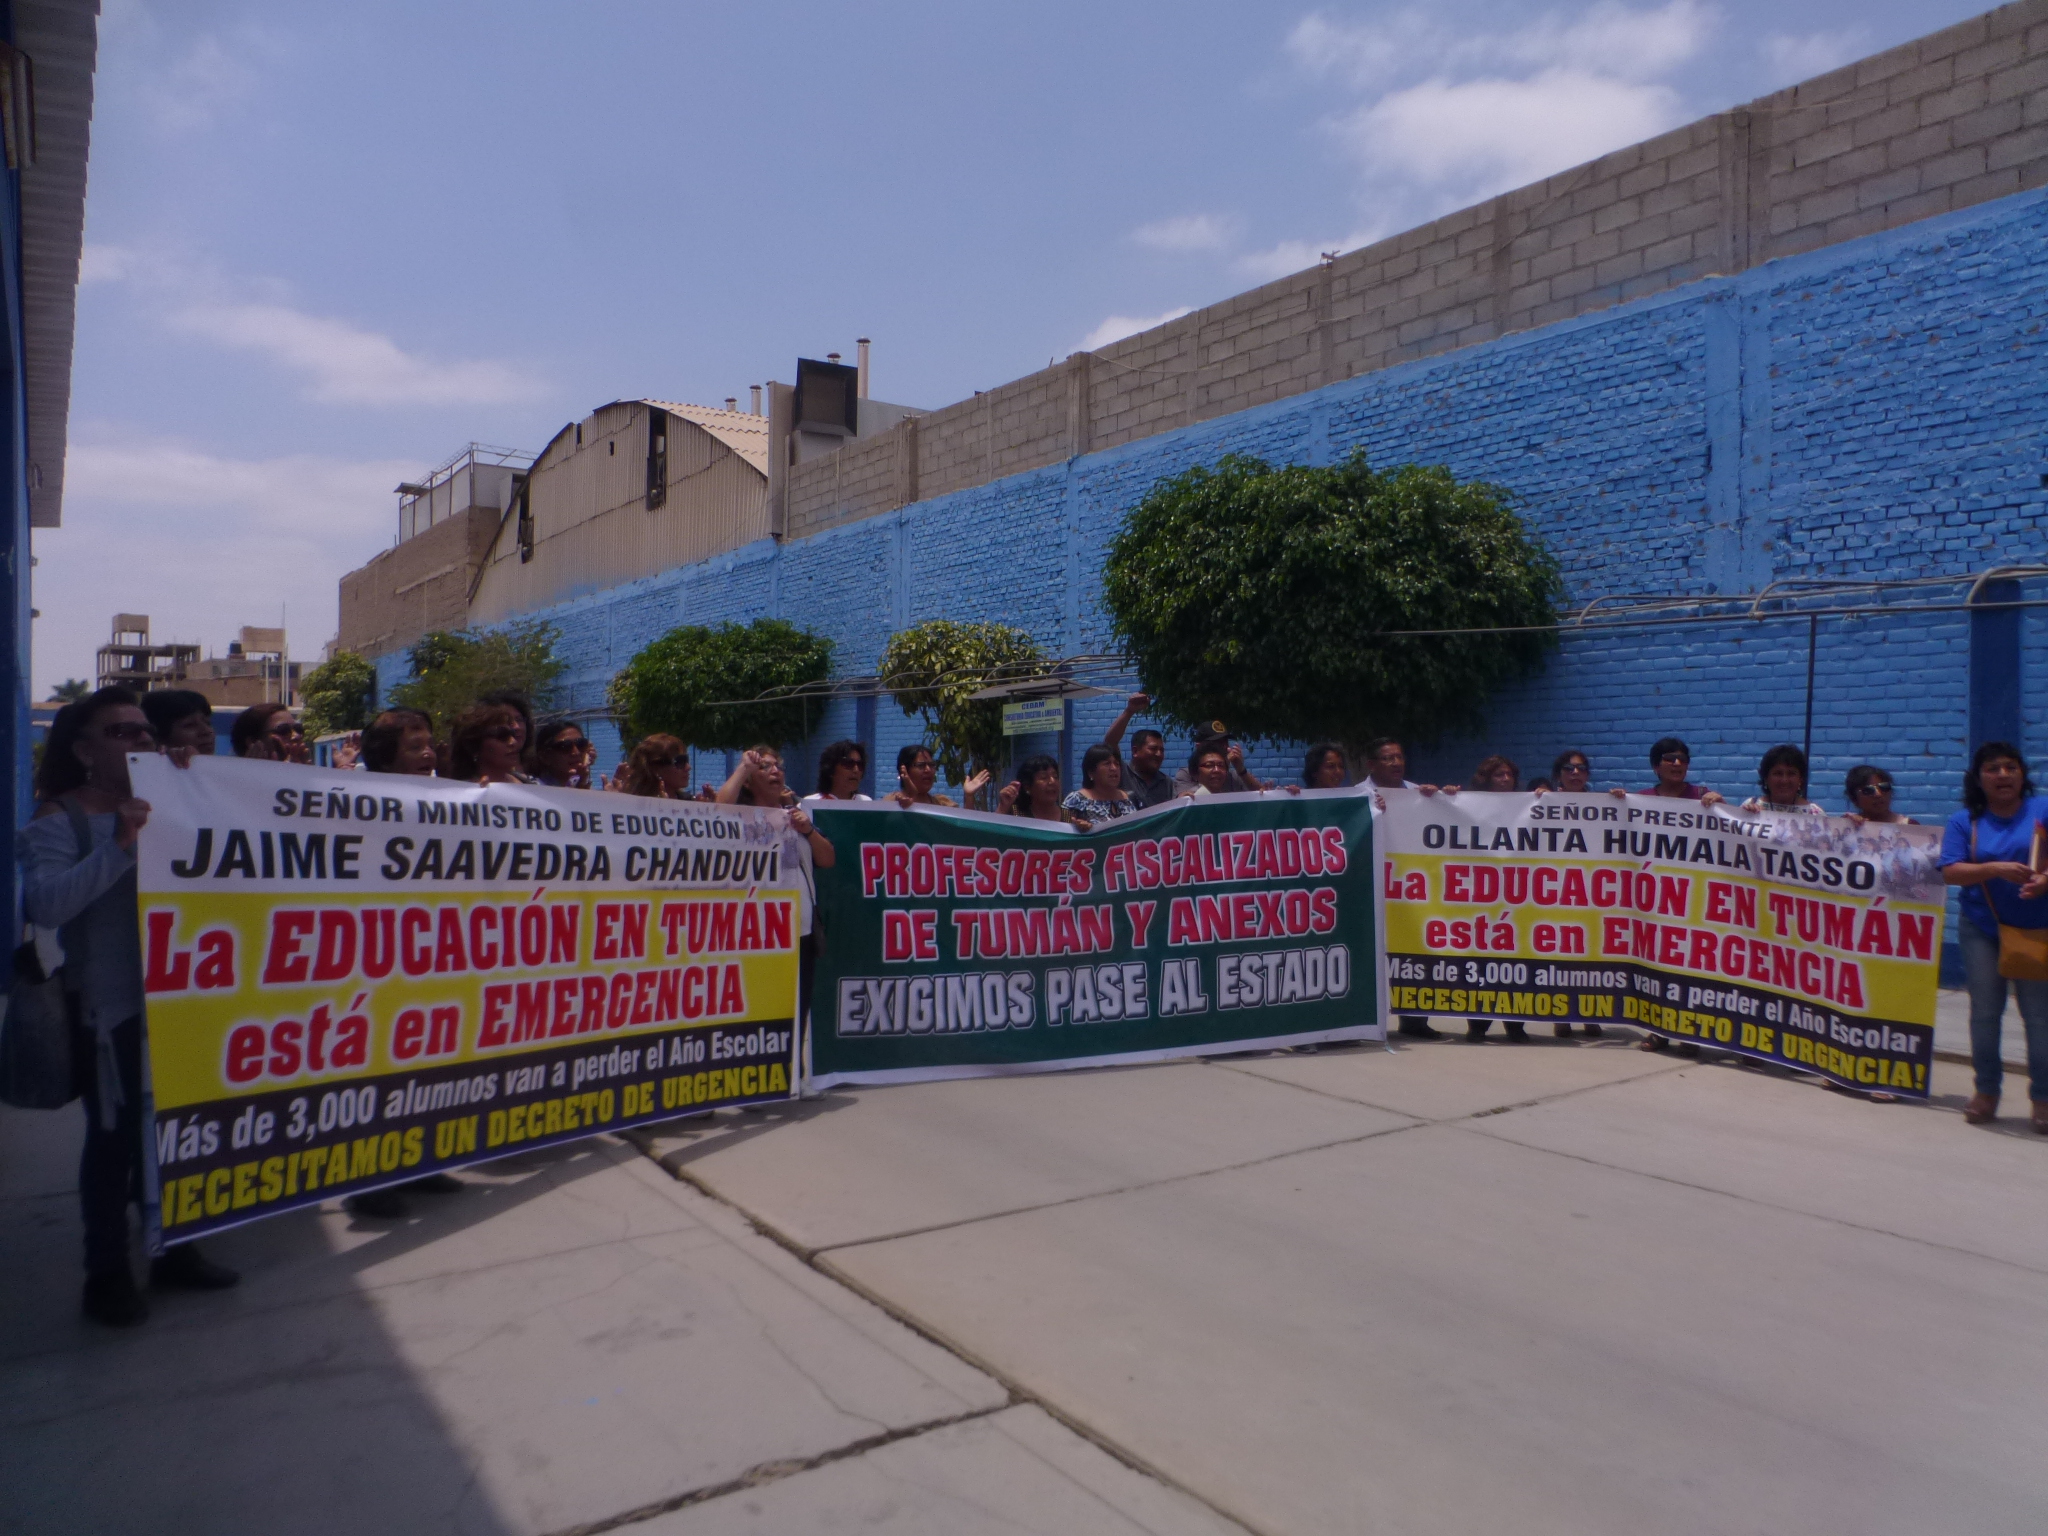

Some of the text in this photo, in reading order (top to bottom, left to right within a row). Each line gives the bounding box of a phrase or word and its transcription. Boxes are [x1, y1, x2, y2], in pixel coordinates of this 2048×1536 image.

[170, 827, 780, 882] JAIME SAAVEDRA CHANDUVÍ
[273, 787, 741, 840] SEÑOR MINISTRO DE EDUCACIÓN
[1422, 823, 1875, 890] OLLANTA HUMALA TASSO
[1529, 802, 1772, 839] SEÑOR PRESIDENTE
[860, 826, 1348, 898] PROFESORES FISCALIZADOS
[144, 887, 792, 992] La EDUCACIÓN EN TUMÁN
[882, 887, 1337, 963] DE TUMÁN Y ANEXOS
[1384, 861, 1934, 961] La EDUCACIÓN EN TUMÁN
[837, 943, 1350, 1037] EXIGIMOS PASE AL ESTADO
[1386, 956, 1921, 1054] Más de 3,000 alumnos van a perder el Año Escolar
[1425, 911, 1864, 1008] está en EMERGENCIA
[225, 964, 745, 1083] está en EMERGENCIA
[1390, 986, 1927, 1091] NECESITAMOS UN DECRETO DE URGENCIA!
[231, 1105, 275, 1149] de
[286, 1085, 378, 1143] 3,000
[383, 1072, 498, 1121] alumnos
[504, 1061, 546, 1093] van
[552, 1060, 566, 1086] a
[572, 1045, 641, 1091] perder
[645, 1038, 664, 1070] el
[668, 1034, 705, 1067] Año
[711, 1026, 790, 1061] Escolar
[434, 1114, 480, 1158] UN
[487, 1088, 615, 1148] DECRETO
[622, 1080, 656, 1118] DE
[662, 1063, 793, 1110] URGENCIA
